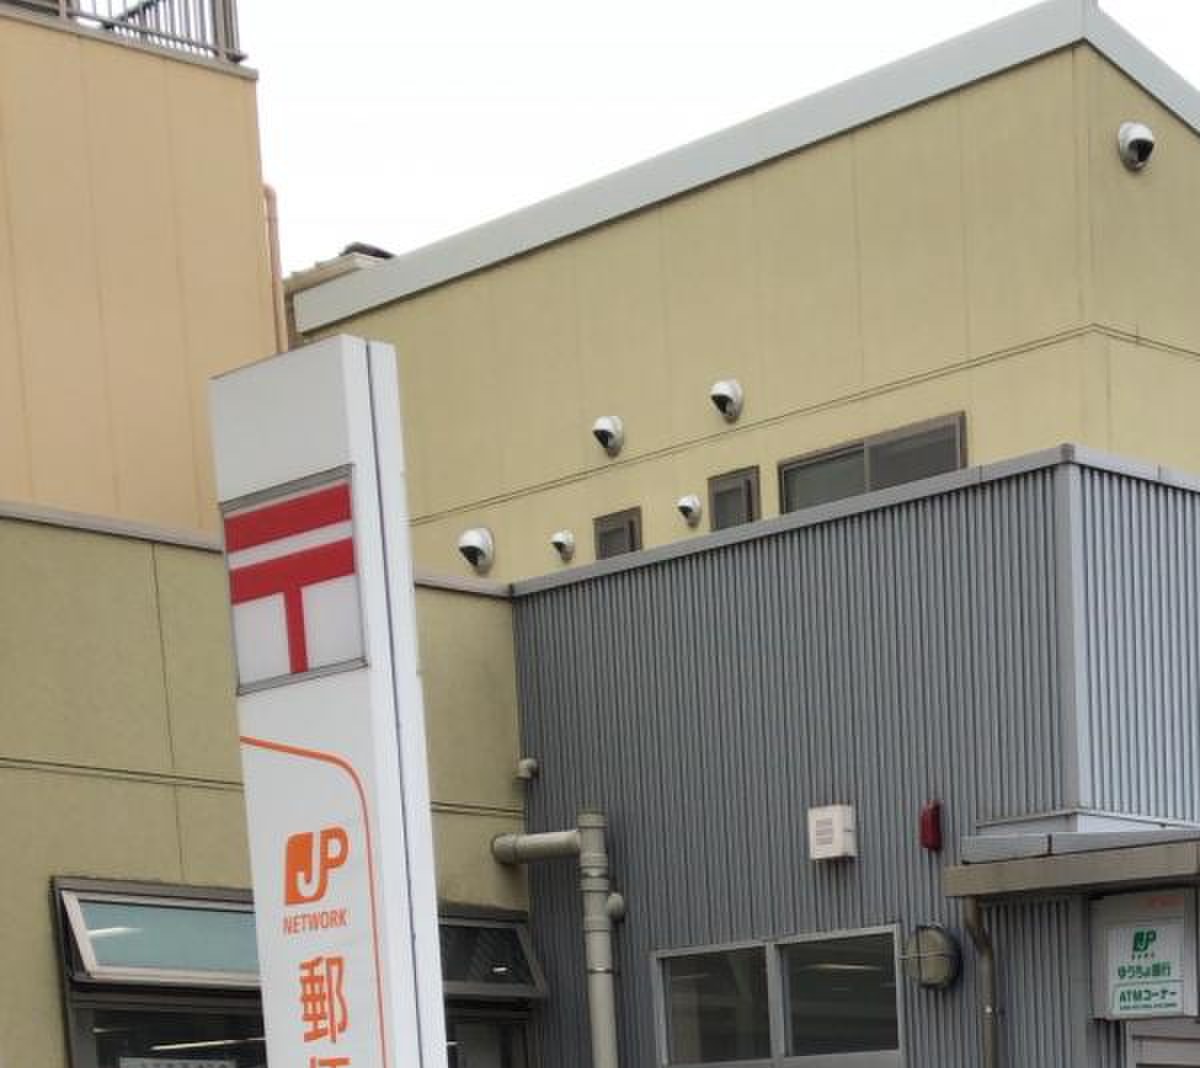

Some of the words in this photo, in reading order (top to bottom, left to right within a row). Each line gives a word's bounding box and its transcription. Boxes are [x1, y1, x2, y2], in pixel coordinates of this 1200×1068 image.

[282, 907, 349, 934] NETWORK
[1117, 961, 1171, 980] ゆうちょ銀行
[1119, 989, 1178, 1003] ATMコーナー
